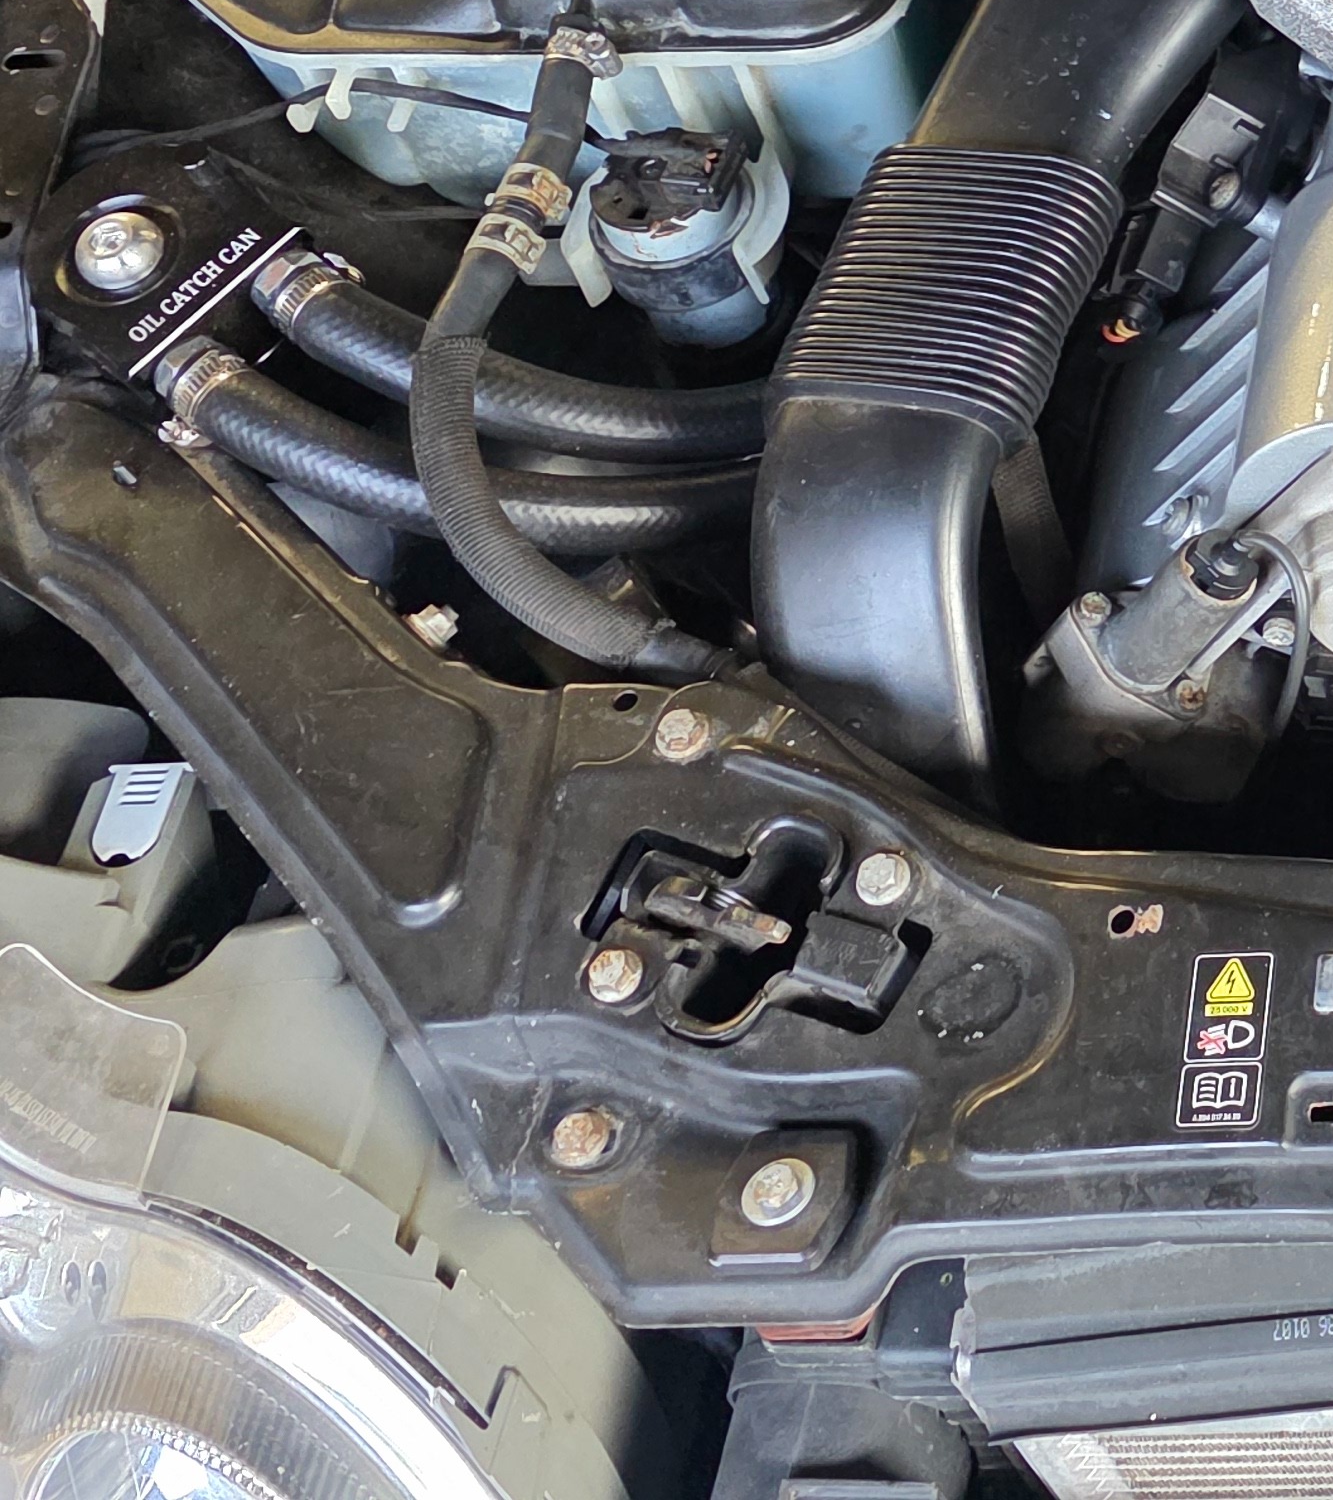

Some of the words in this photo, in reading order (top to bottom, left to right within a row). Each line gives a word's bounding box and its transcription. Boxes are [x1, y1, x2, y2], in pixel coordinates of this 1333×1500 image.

[128, 314, 166, 343] OIL
[159, 260, 225, 315] CATCH
[217, 227, 263, 265] CAN
[1273, 1317, 1310, 1341] 0107
